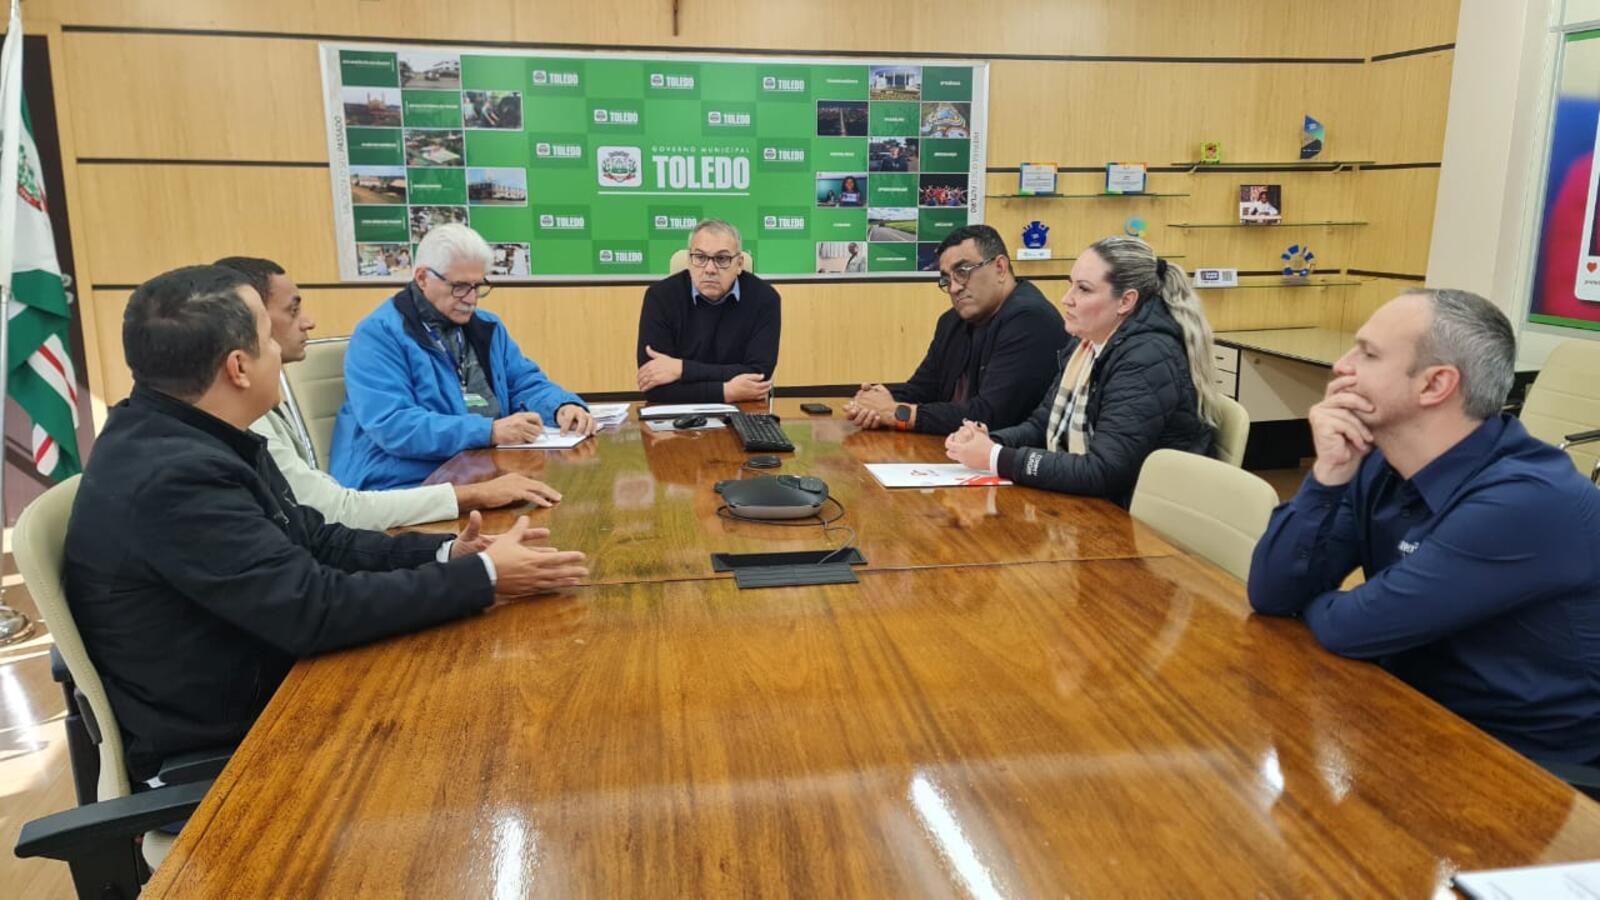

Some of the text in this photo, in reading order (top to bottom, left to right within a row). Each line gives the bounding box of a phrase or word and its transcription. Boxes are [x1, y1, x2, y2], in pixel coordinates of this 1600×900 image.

[549, 73, 579, 85] TOLEDO
[666, 76, 695, 88] TOLEDO
[778, 79, 805, 90] TOLEDO
[609, 112, 638, 123] TOLEDO
[724, 113, 751, 124] TOLEDO
[552, 145, 582, 156] TOLEDO
[652, 145, 750, 154] GOVERNO MUNICIPAL
[779, 150, 805, 160] TOLEDO
[652, 155, 750, 190] TOLEDO
[555, 216, 585, 227] TOLEDO
[670, 217, 698, 228] TOLEDO
[779, 218, 805, 228] TOLEDO
[614, 252, 643, 262] TOLEDO
